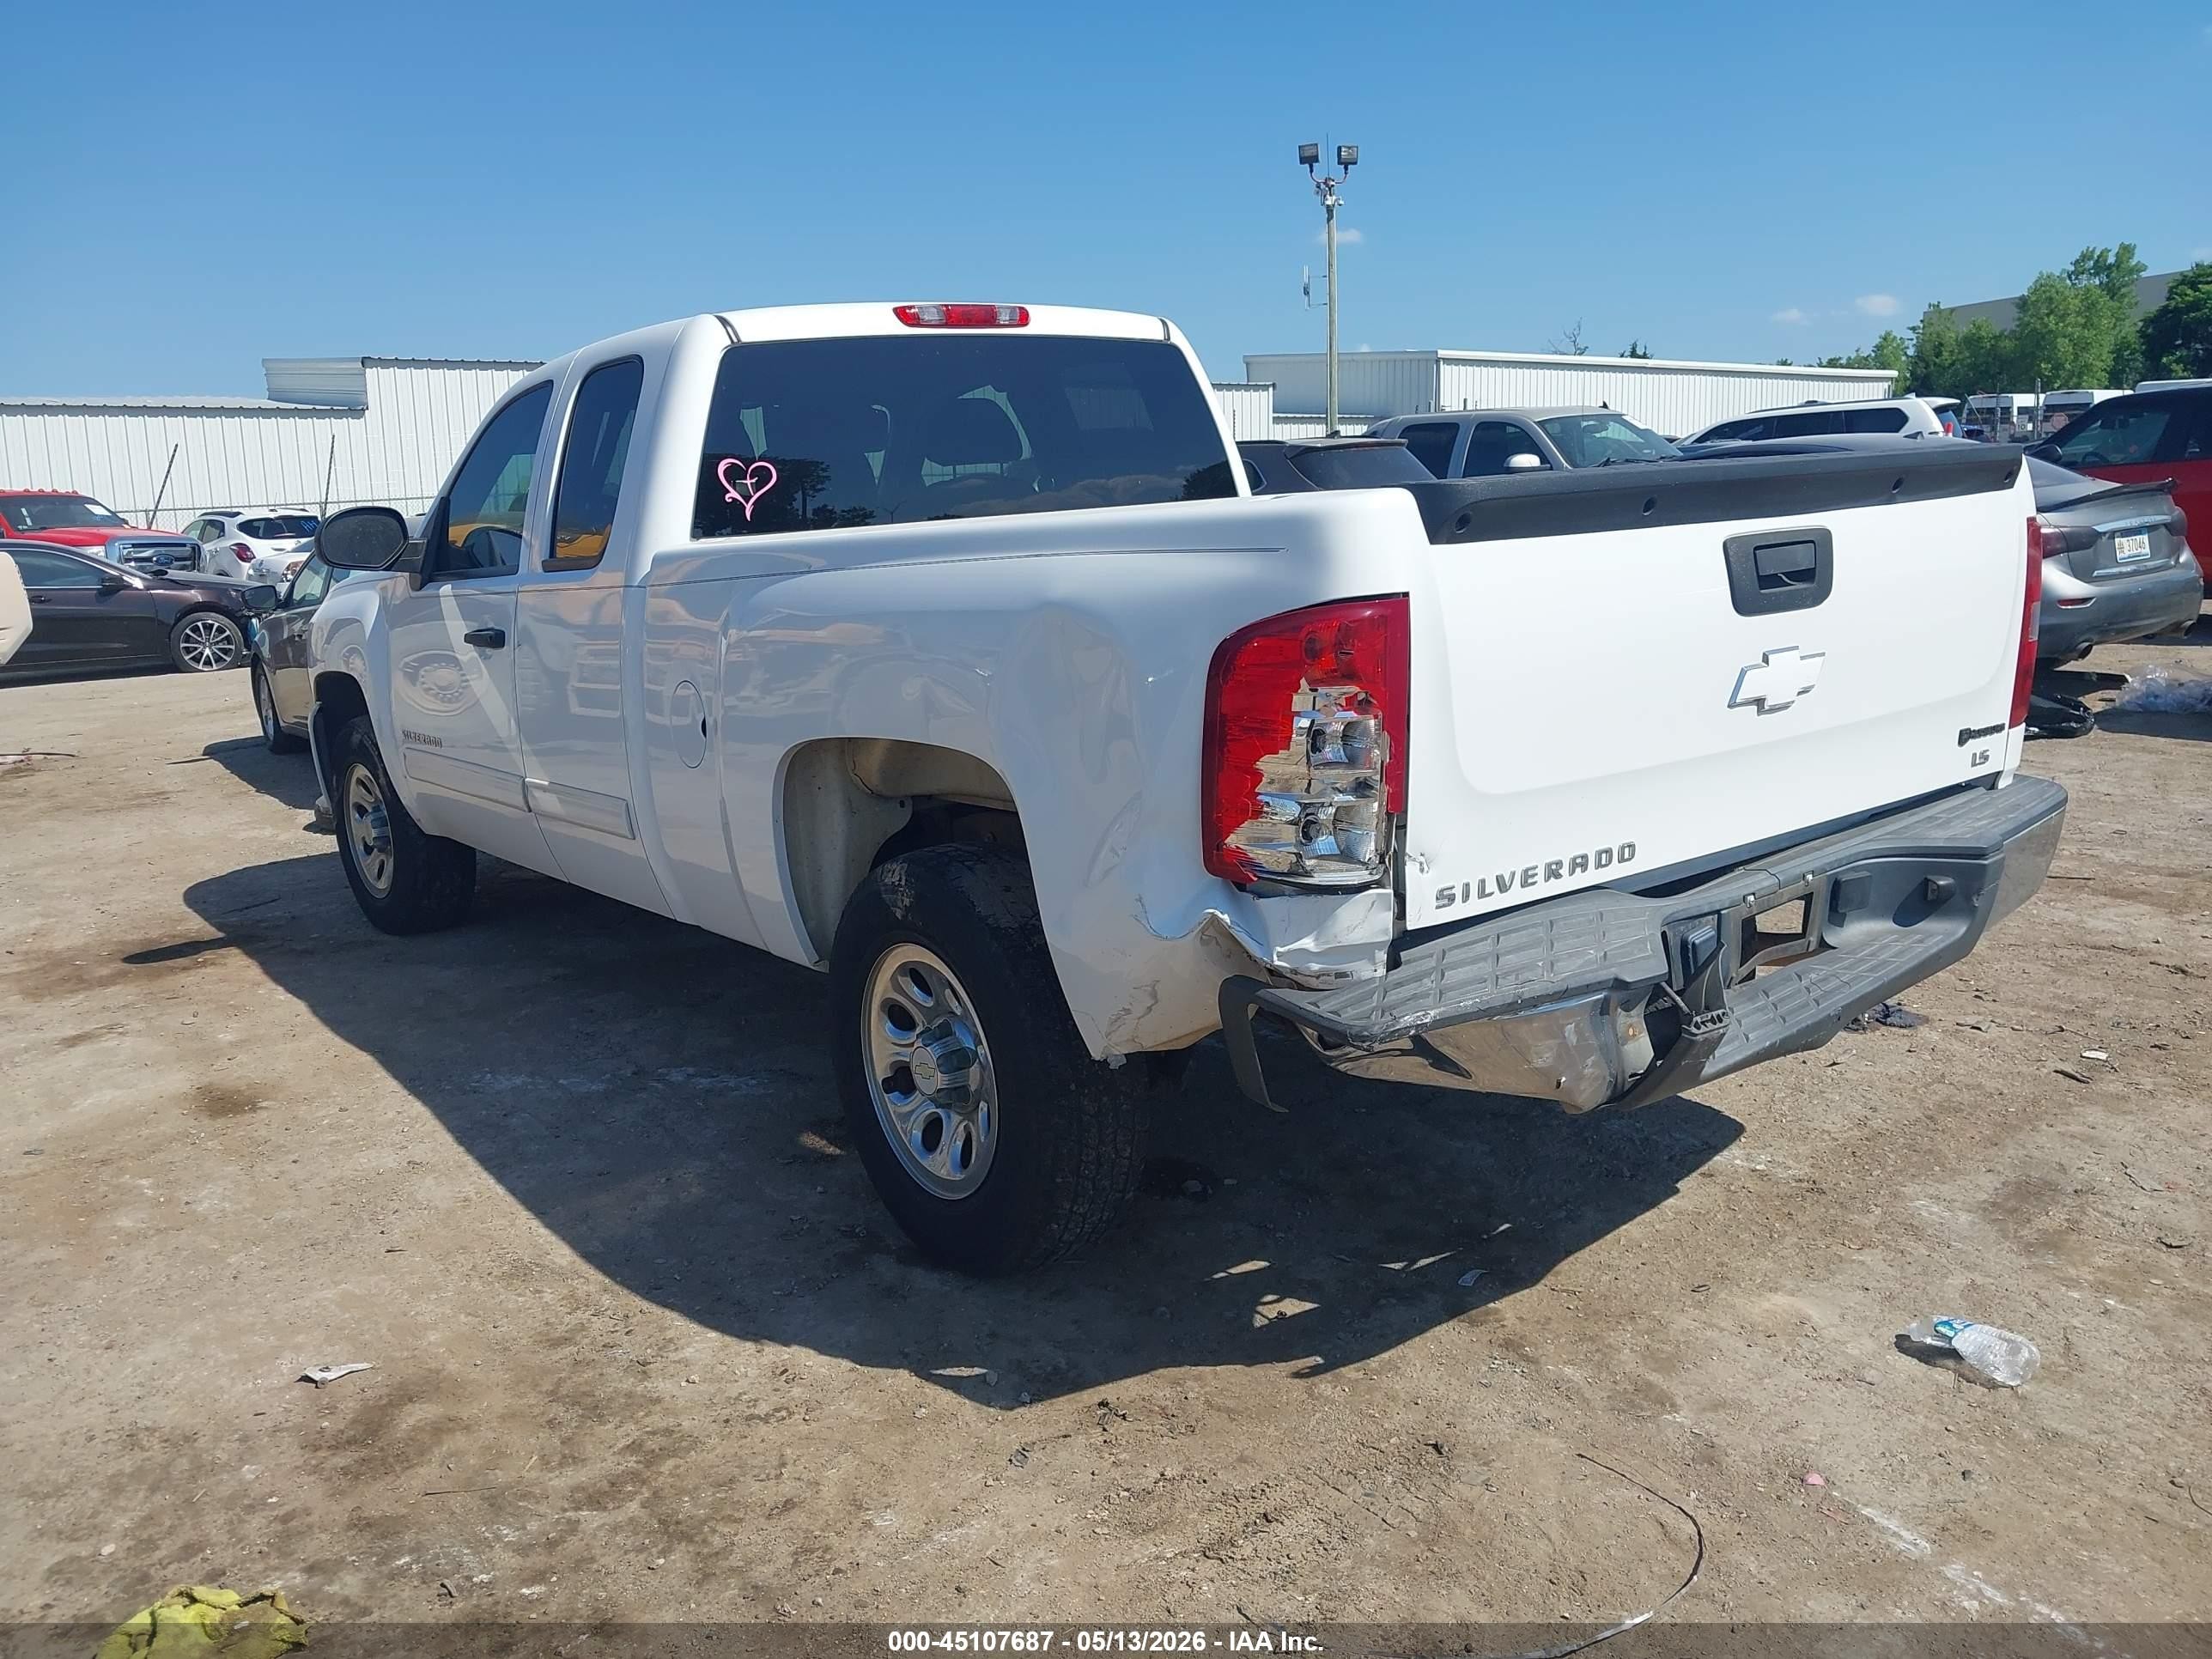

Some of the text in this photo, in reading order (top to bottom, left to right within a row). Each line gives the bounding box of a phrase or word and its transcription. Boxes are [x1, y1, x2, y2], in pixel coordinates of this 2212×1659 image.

[2126, 537, 2146, 552] 37046
[1971, 749, 1990, 768] LS
[1435, 841, 1637, 910] SILVERADO
